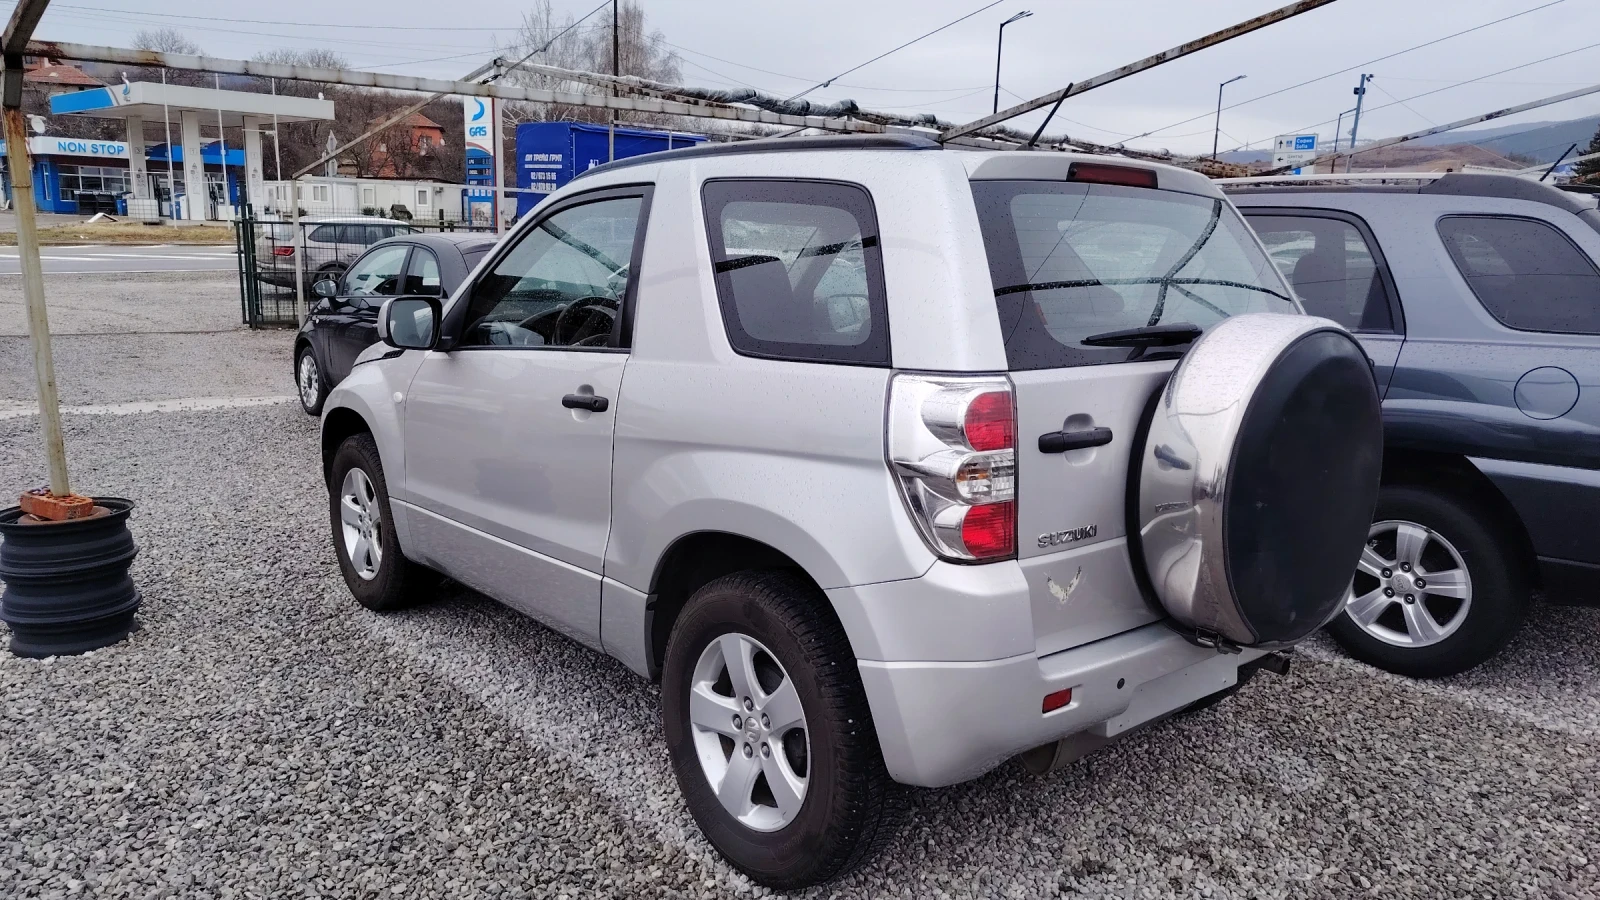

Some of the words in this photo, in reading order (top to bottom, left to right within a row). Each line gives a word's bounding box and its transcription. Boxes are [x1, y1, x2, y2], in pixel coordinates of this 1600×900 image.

[469, 126, 487, 137] GAS
[57, 141, 87, 153] NON
[91, 143, 125, 155] STOP
[1037, 525, 1098, 548] SUZUKI
